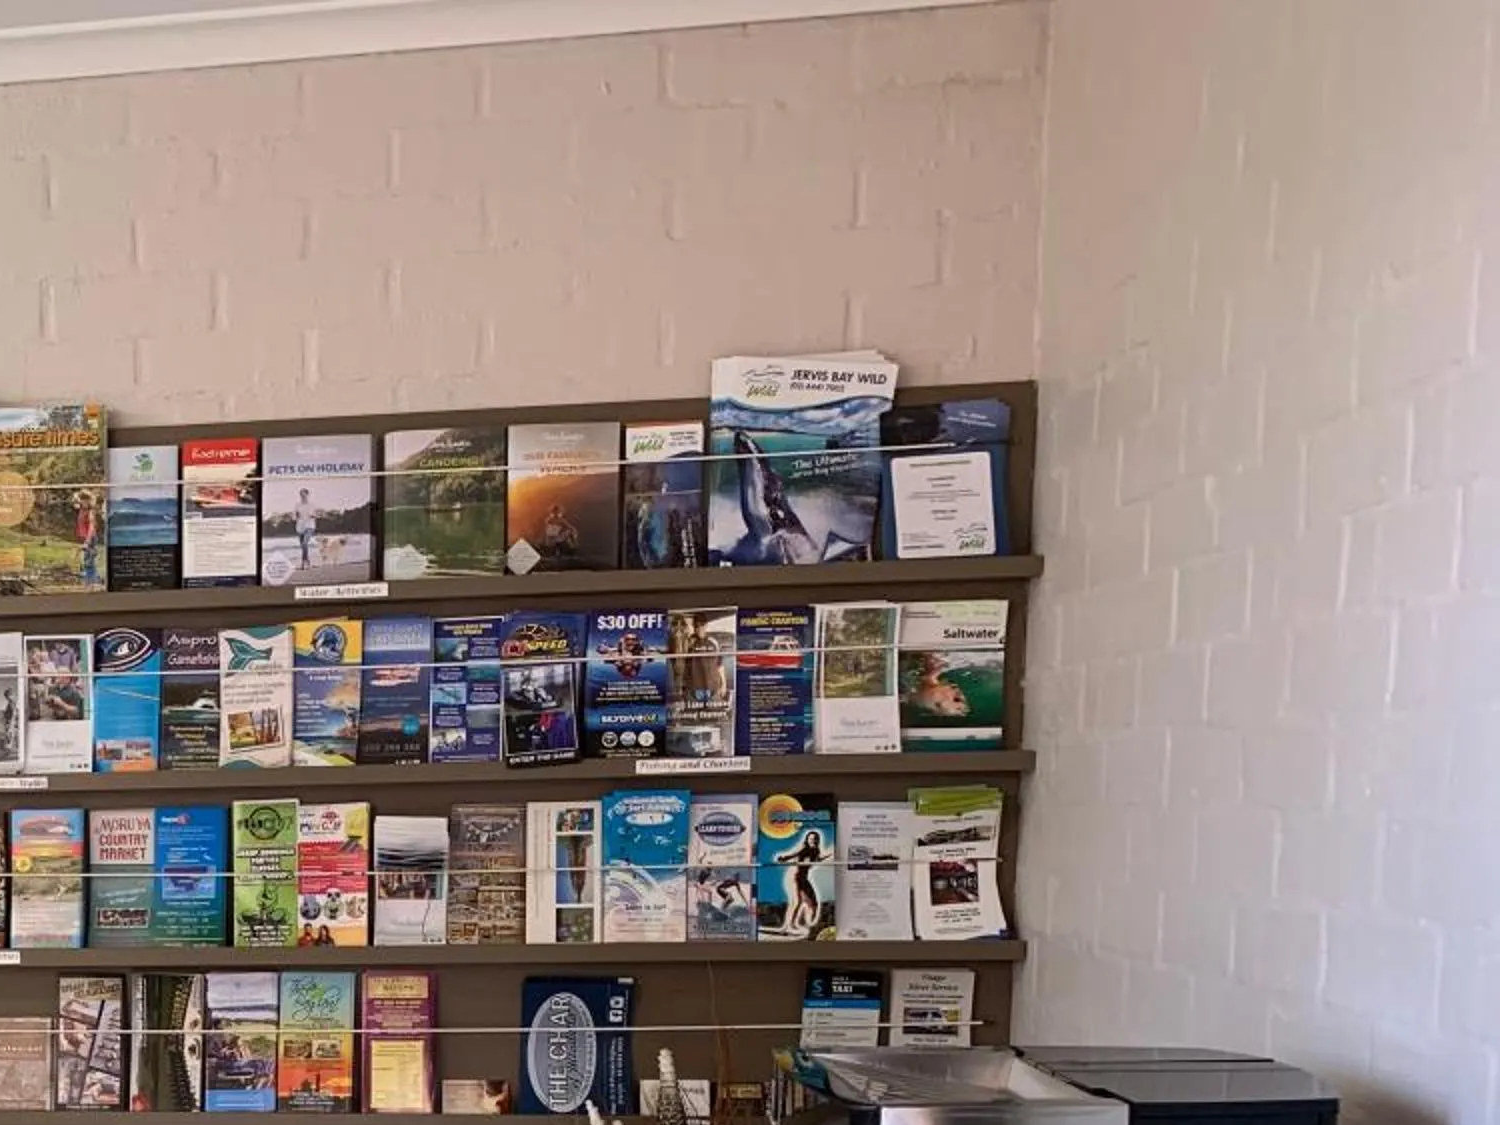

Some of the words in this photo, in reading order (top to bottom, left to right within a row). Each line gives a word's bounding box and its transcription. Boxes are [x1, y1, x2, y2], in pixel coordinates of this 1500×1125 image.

[791, 369, 829, 382] JERVIS
[831, 371, 854, 383] BAY
[857, 373, 888, 385] WILD
[44, 428, 100, 448] times
[268, 463, 295, 475] PETS
[298, 463, 315, 474] ON
[317, 462, 365, 474] HOLIDAY
[597, 615, 627, 630] $30
[629, 613, 664, 629] OFF!
[943, 627, 999, 639] Saltwater
[100, 816, 151, 832] MORUYA
[99, 834, 149, 847] COUNTRY
[99, 847, 147, 861] MARKET
[549, 997, 571, 1061] CHAR
[549, 1068, 568, 1106] THE
